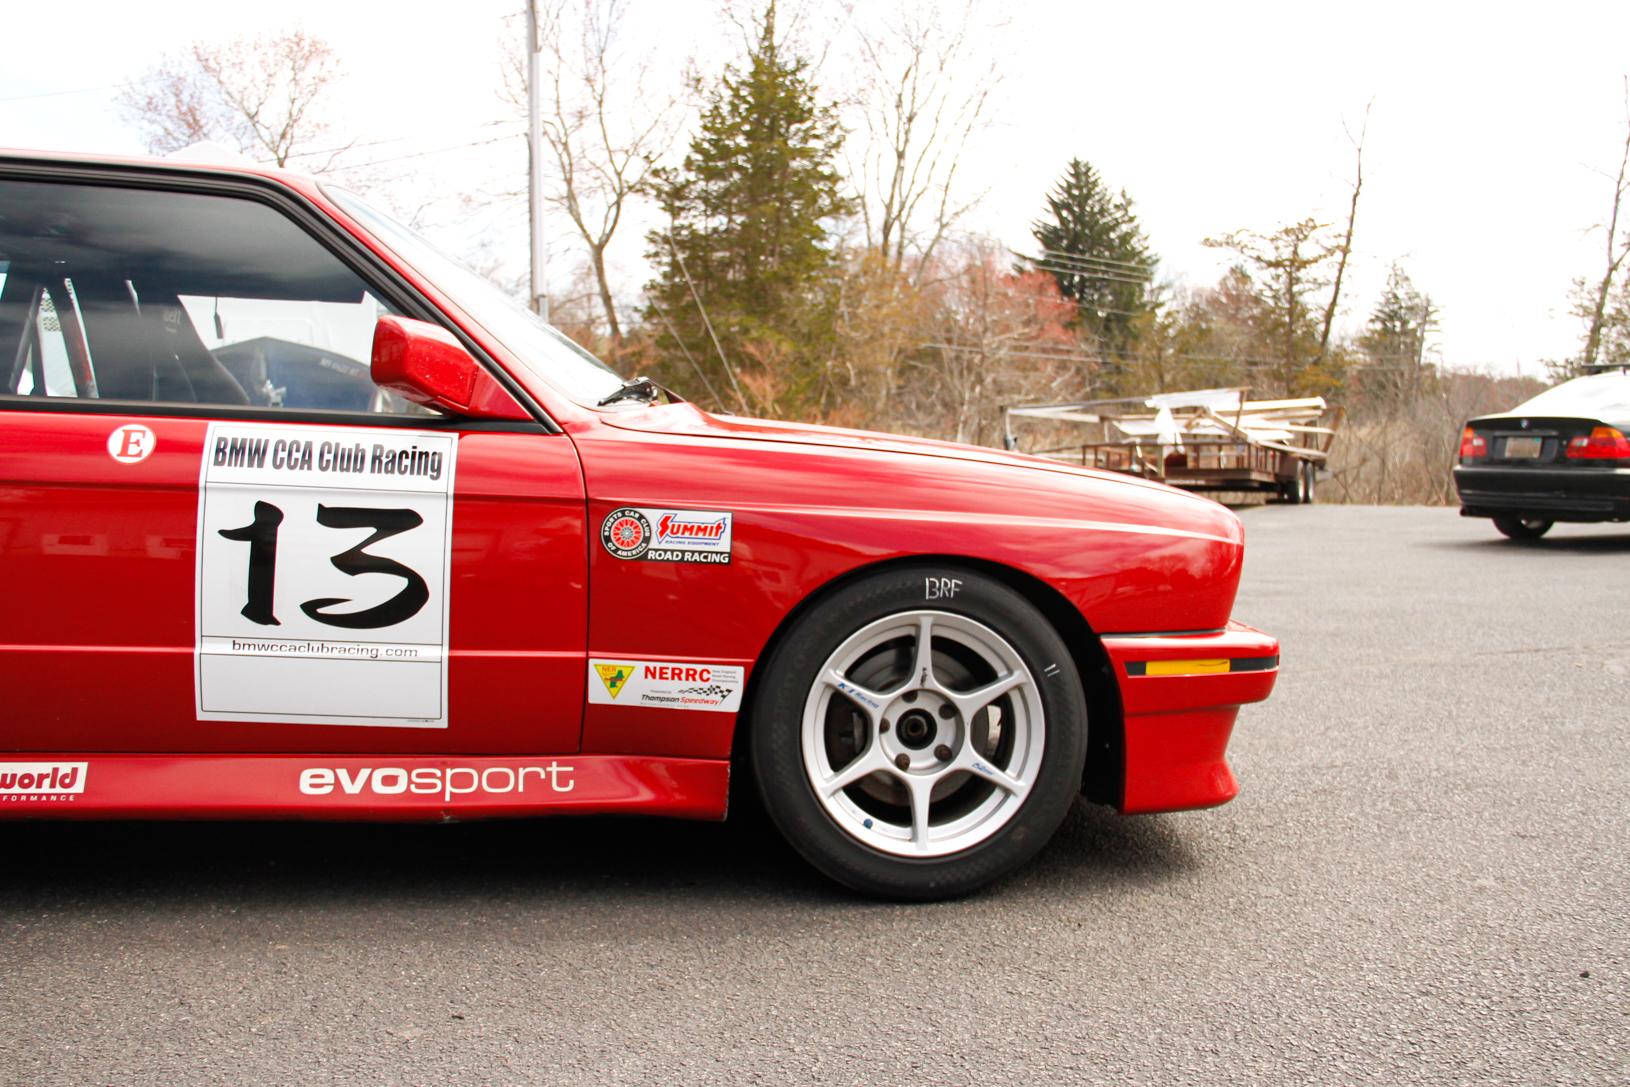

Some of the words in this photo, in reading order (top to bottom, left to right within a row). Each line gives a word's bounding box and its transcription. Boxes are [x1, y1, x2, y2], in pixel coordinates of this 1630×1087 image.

[116, 429, 146, 458] E
[213, 436, 269, 469] BMW
[271, 438, 313, 471] CCA
[318, 441, 366, 474] Club
[370, 443, 443, 481] Racing
[624, 510, 640, 519] CAR
[616, 542, 647, 557] AMERICA
[647, 550, 682, 561] ROAD
[683, 551, 729, 563] RACING
[217, 500, 430, 629] 13
[232, 639, 419, 659] bmwccaclubracing.com
[644, 665, 712, 683] NERRC
[641, 694, 680, 703] Thompson
[680, 696, 719, 706] Speedway
[299, 761, 575, 802] evosport
